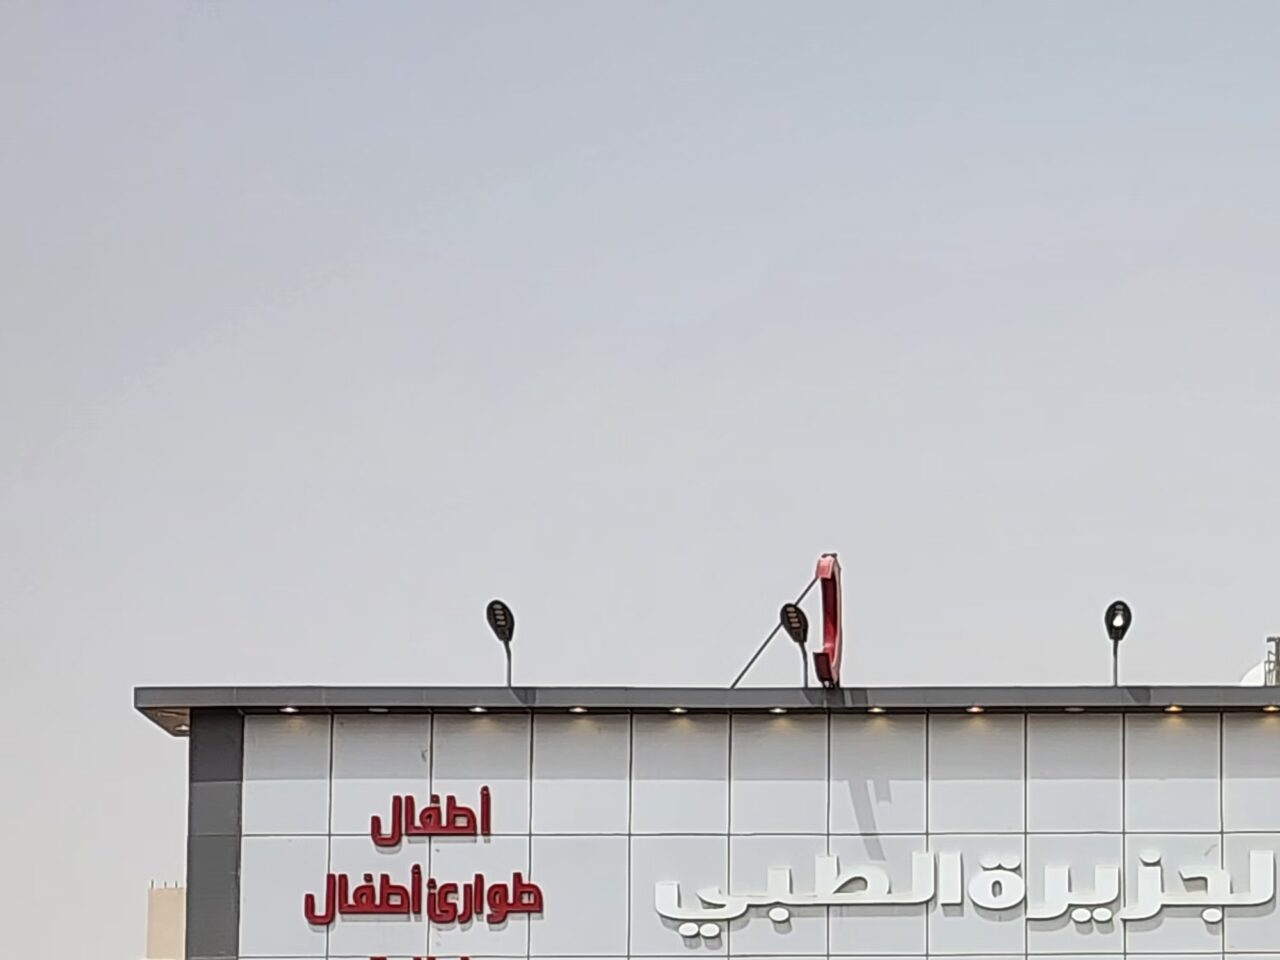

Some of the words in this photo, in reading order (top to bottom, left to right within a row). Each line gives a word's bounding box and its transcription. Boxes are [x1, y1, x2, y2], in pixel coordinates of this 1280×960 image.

[370, 786, 492, 849] أطفال
[304, 863, 423, 927] أطفال
[426, 872, 545, 925] طوارئ
[654, 850, 963, 939] الطبي
